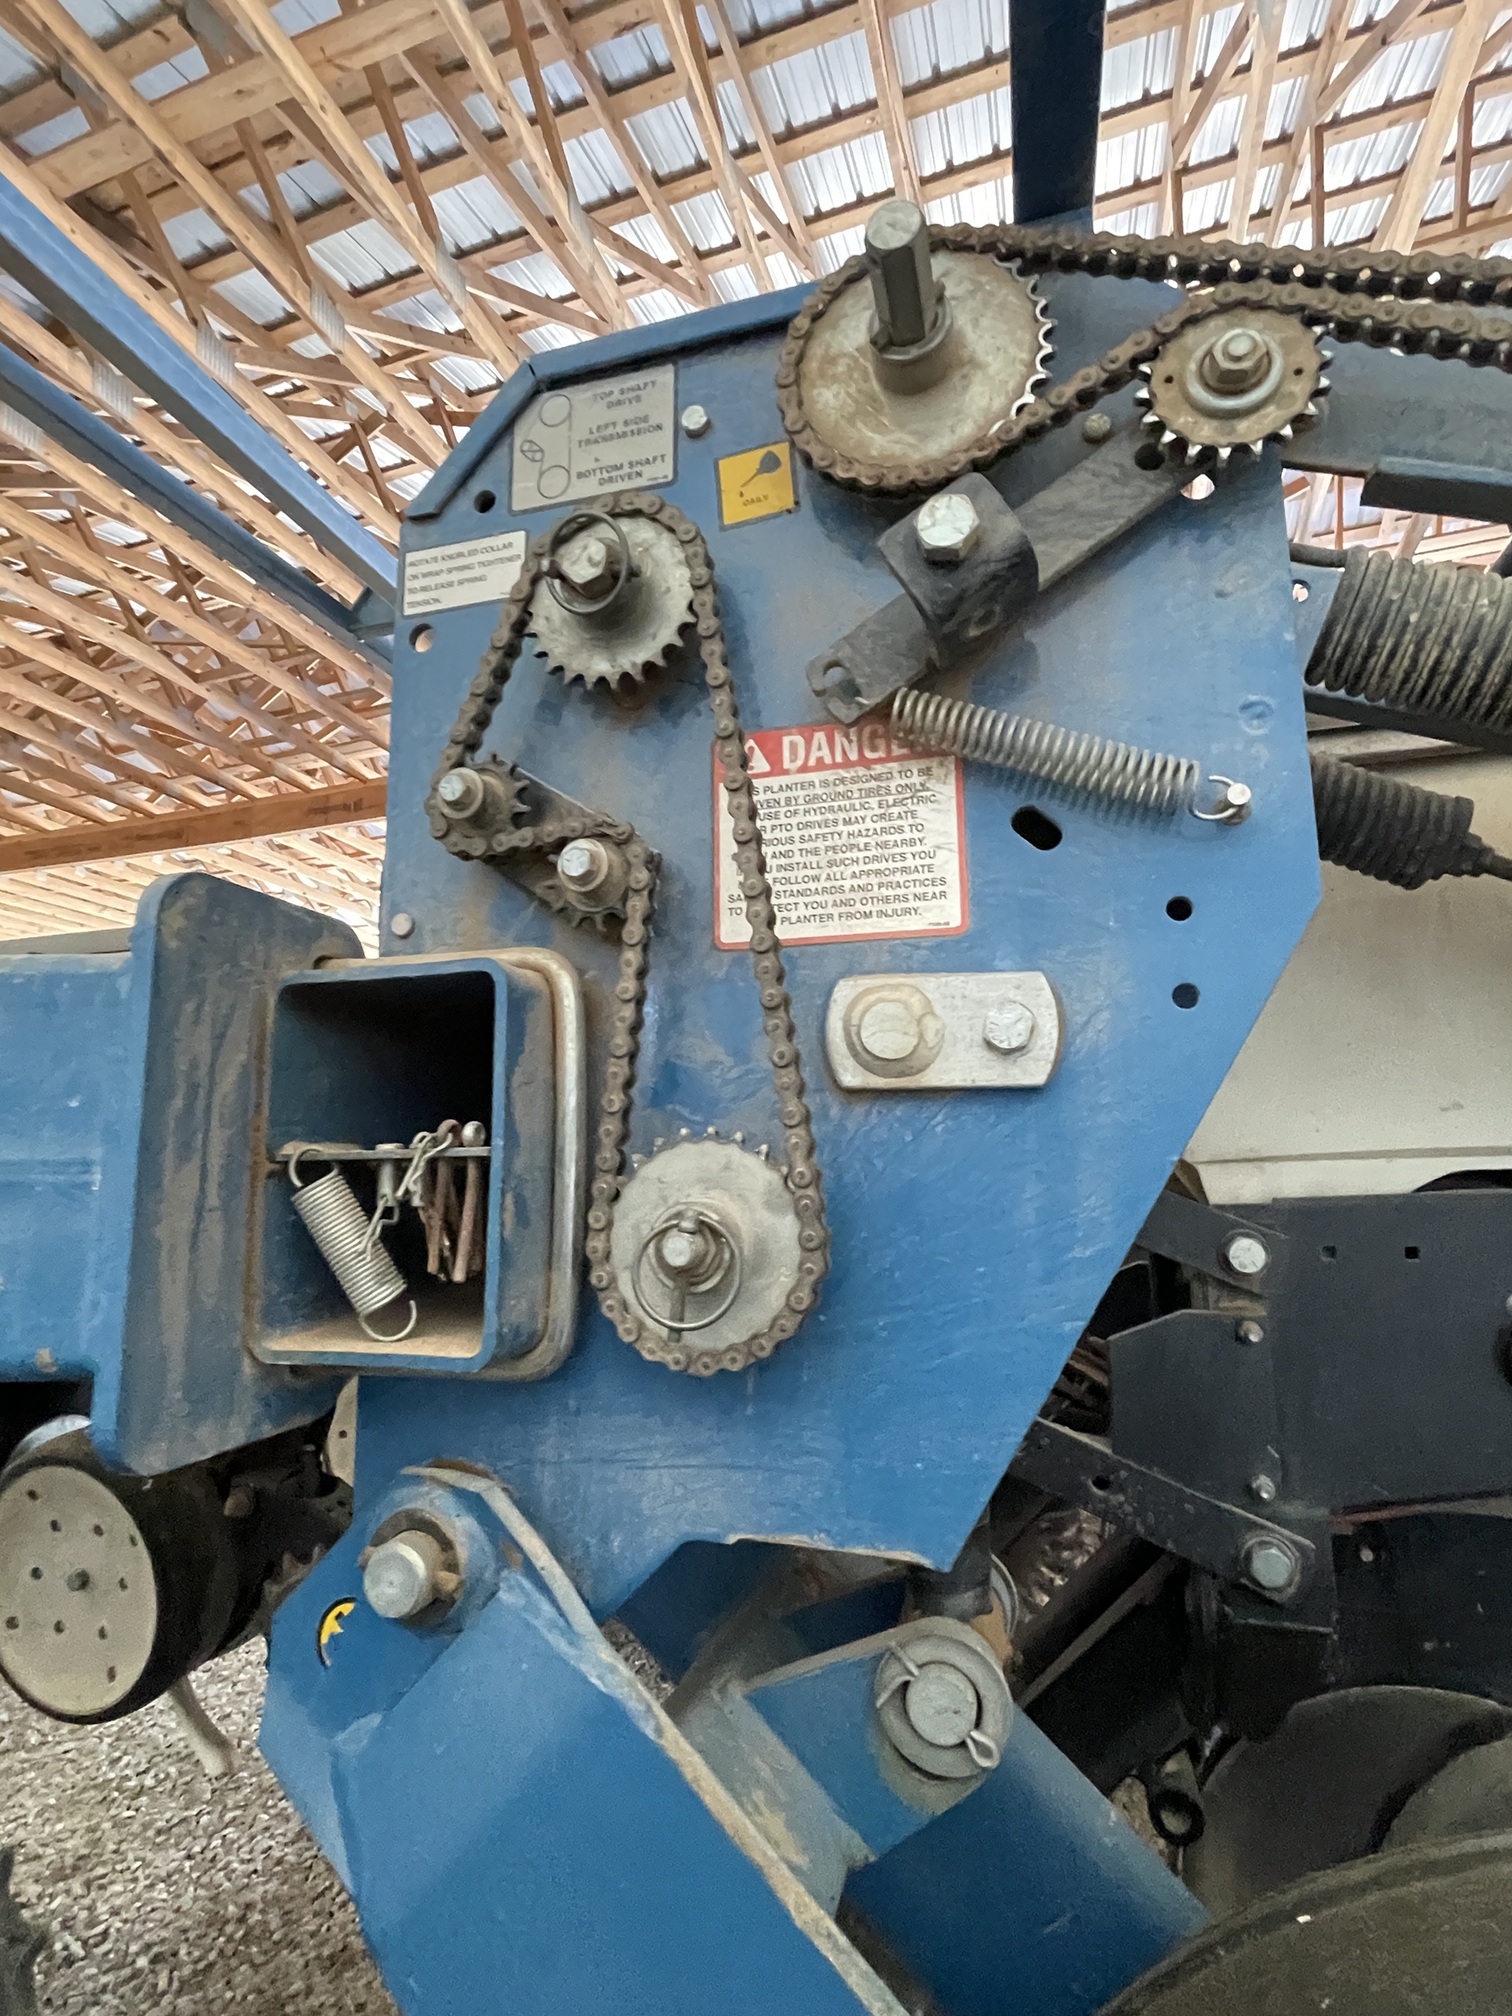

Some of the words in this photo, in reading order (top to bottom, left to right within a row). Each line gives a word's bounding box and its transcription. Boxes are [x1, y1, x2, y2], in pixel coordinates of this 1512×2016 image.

[593, 390, 615, 402] TOP
[607, 394, 643, 409] DRIVE
[589, 421, 617, 434] LEFT
[623, 414, 650, 426] SIDE
[577, 423, 664, 448] TRANSMISSION
[575, 461, 624, 480] BOTTOM
[628, 454, 666, 470] SHAFT
[598, 471, 643, 486] DRIVEN
[480, 541, 513, 554] COLLAR
[764, 780, 815, 795] PLANTER
[819, 779, 830, 788] IS
[832, 771, 893, 787] DESIGNED
[898, 769, 914, 779] TO
[917, 767, 934, 777] BE
[785, 795, 801, 805] BY
[804, 790, 853, 804] GROUND
[858, 785, 891, 798] TIRES
[758, 810, 780, 821] USE
[785, 808, 801, 818] OF
[878, 794, 937, 809] ELECTRIC
[770, 823, 793, 834] PTO
[797, 818, 839, 831] DRIVES
[843, 815, 870, 827] MAY
[871, 809, 918, 823] CREATE
[761, 837, 795, 847] RIOUS
[799, 831, 843, 844] SAFETY
[848, 824, 905, 839] HAZARDS
[909, 823, 925, 833] TO
[771, 849, 795, 859] AND
[797, 846, 821, 857] THE
[825, 841, 872, 855] PEOPLE
[876, 837, 927, 850] NEARBY.
[776, 859, 823, 872] INSTALL
[827, 855, 859, 868] SUCH
[863, 852, 907, 865] DRIVES
[911, 850, 936, 860] YOU
[773, 873, 822, 886] FOLLOW
[825, 870, 847, 881] ALL
[851, 864, 935, 879] APPROPRIATE
[775, 885, 845, 899] STANDARDS
[848, 883, 874, 894] AND
[877, 877, 947, 891] PRACTICES
[728, 907, 743, 916] TO
[803, 900, 828, 910] YOU
[831, 898, 856, 908] AND
[860, 893, 909, 906] OTHERS
[913, 891, 947, 902] NEAR
[781, 912, 835, 926] PLANTER
[838, 910, 873, 922] FROM
[876, 907, 922, 919] INJURY.
